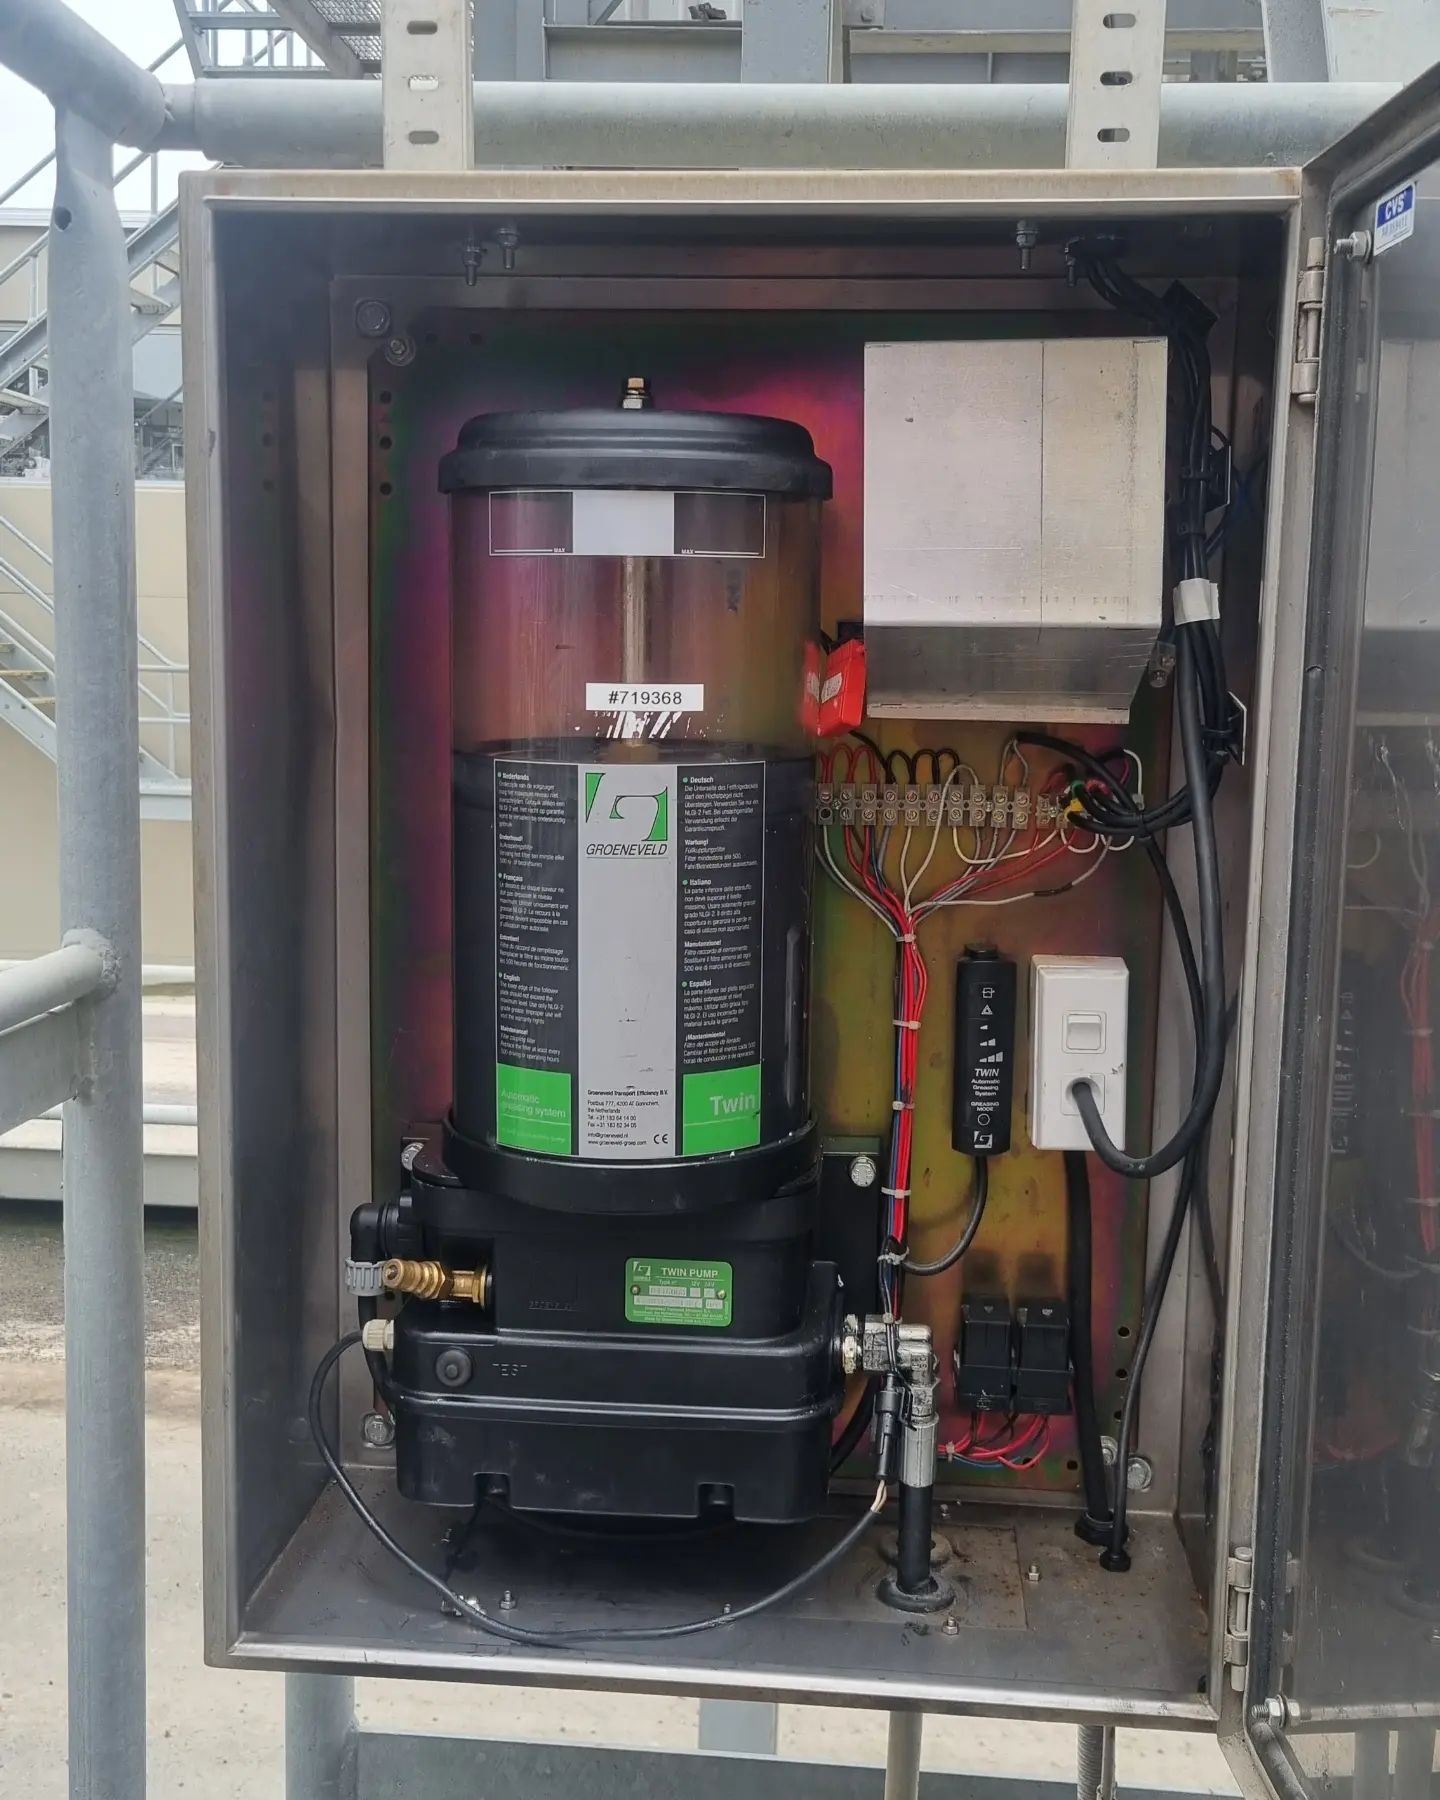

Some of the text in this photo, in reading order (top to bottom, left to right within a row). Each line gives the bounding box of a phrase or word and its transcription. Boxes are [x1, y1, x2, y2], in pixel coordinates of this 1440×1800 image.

[1385, 193, 1405, 220] CVS
[609, 691, 682, 704] #719368
[586, 844, 668, 856] GROENEVELD
[503, 873, 523, 882] Français
[503, 973, 520, 981] English
[689, 979, 711, 988] Español
[975, 1068, 999, 1076] TWIN
[501, 1088, 539, 1104] Automatic
[709, 1092, 756, 1116] Twin
[535, 1107, 566, 1118] system
[661, 1268, 719, 1278] TWIN PUMP
[492, 1363, 528, 1377] TEST
